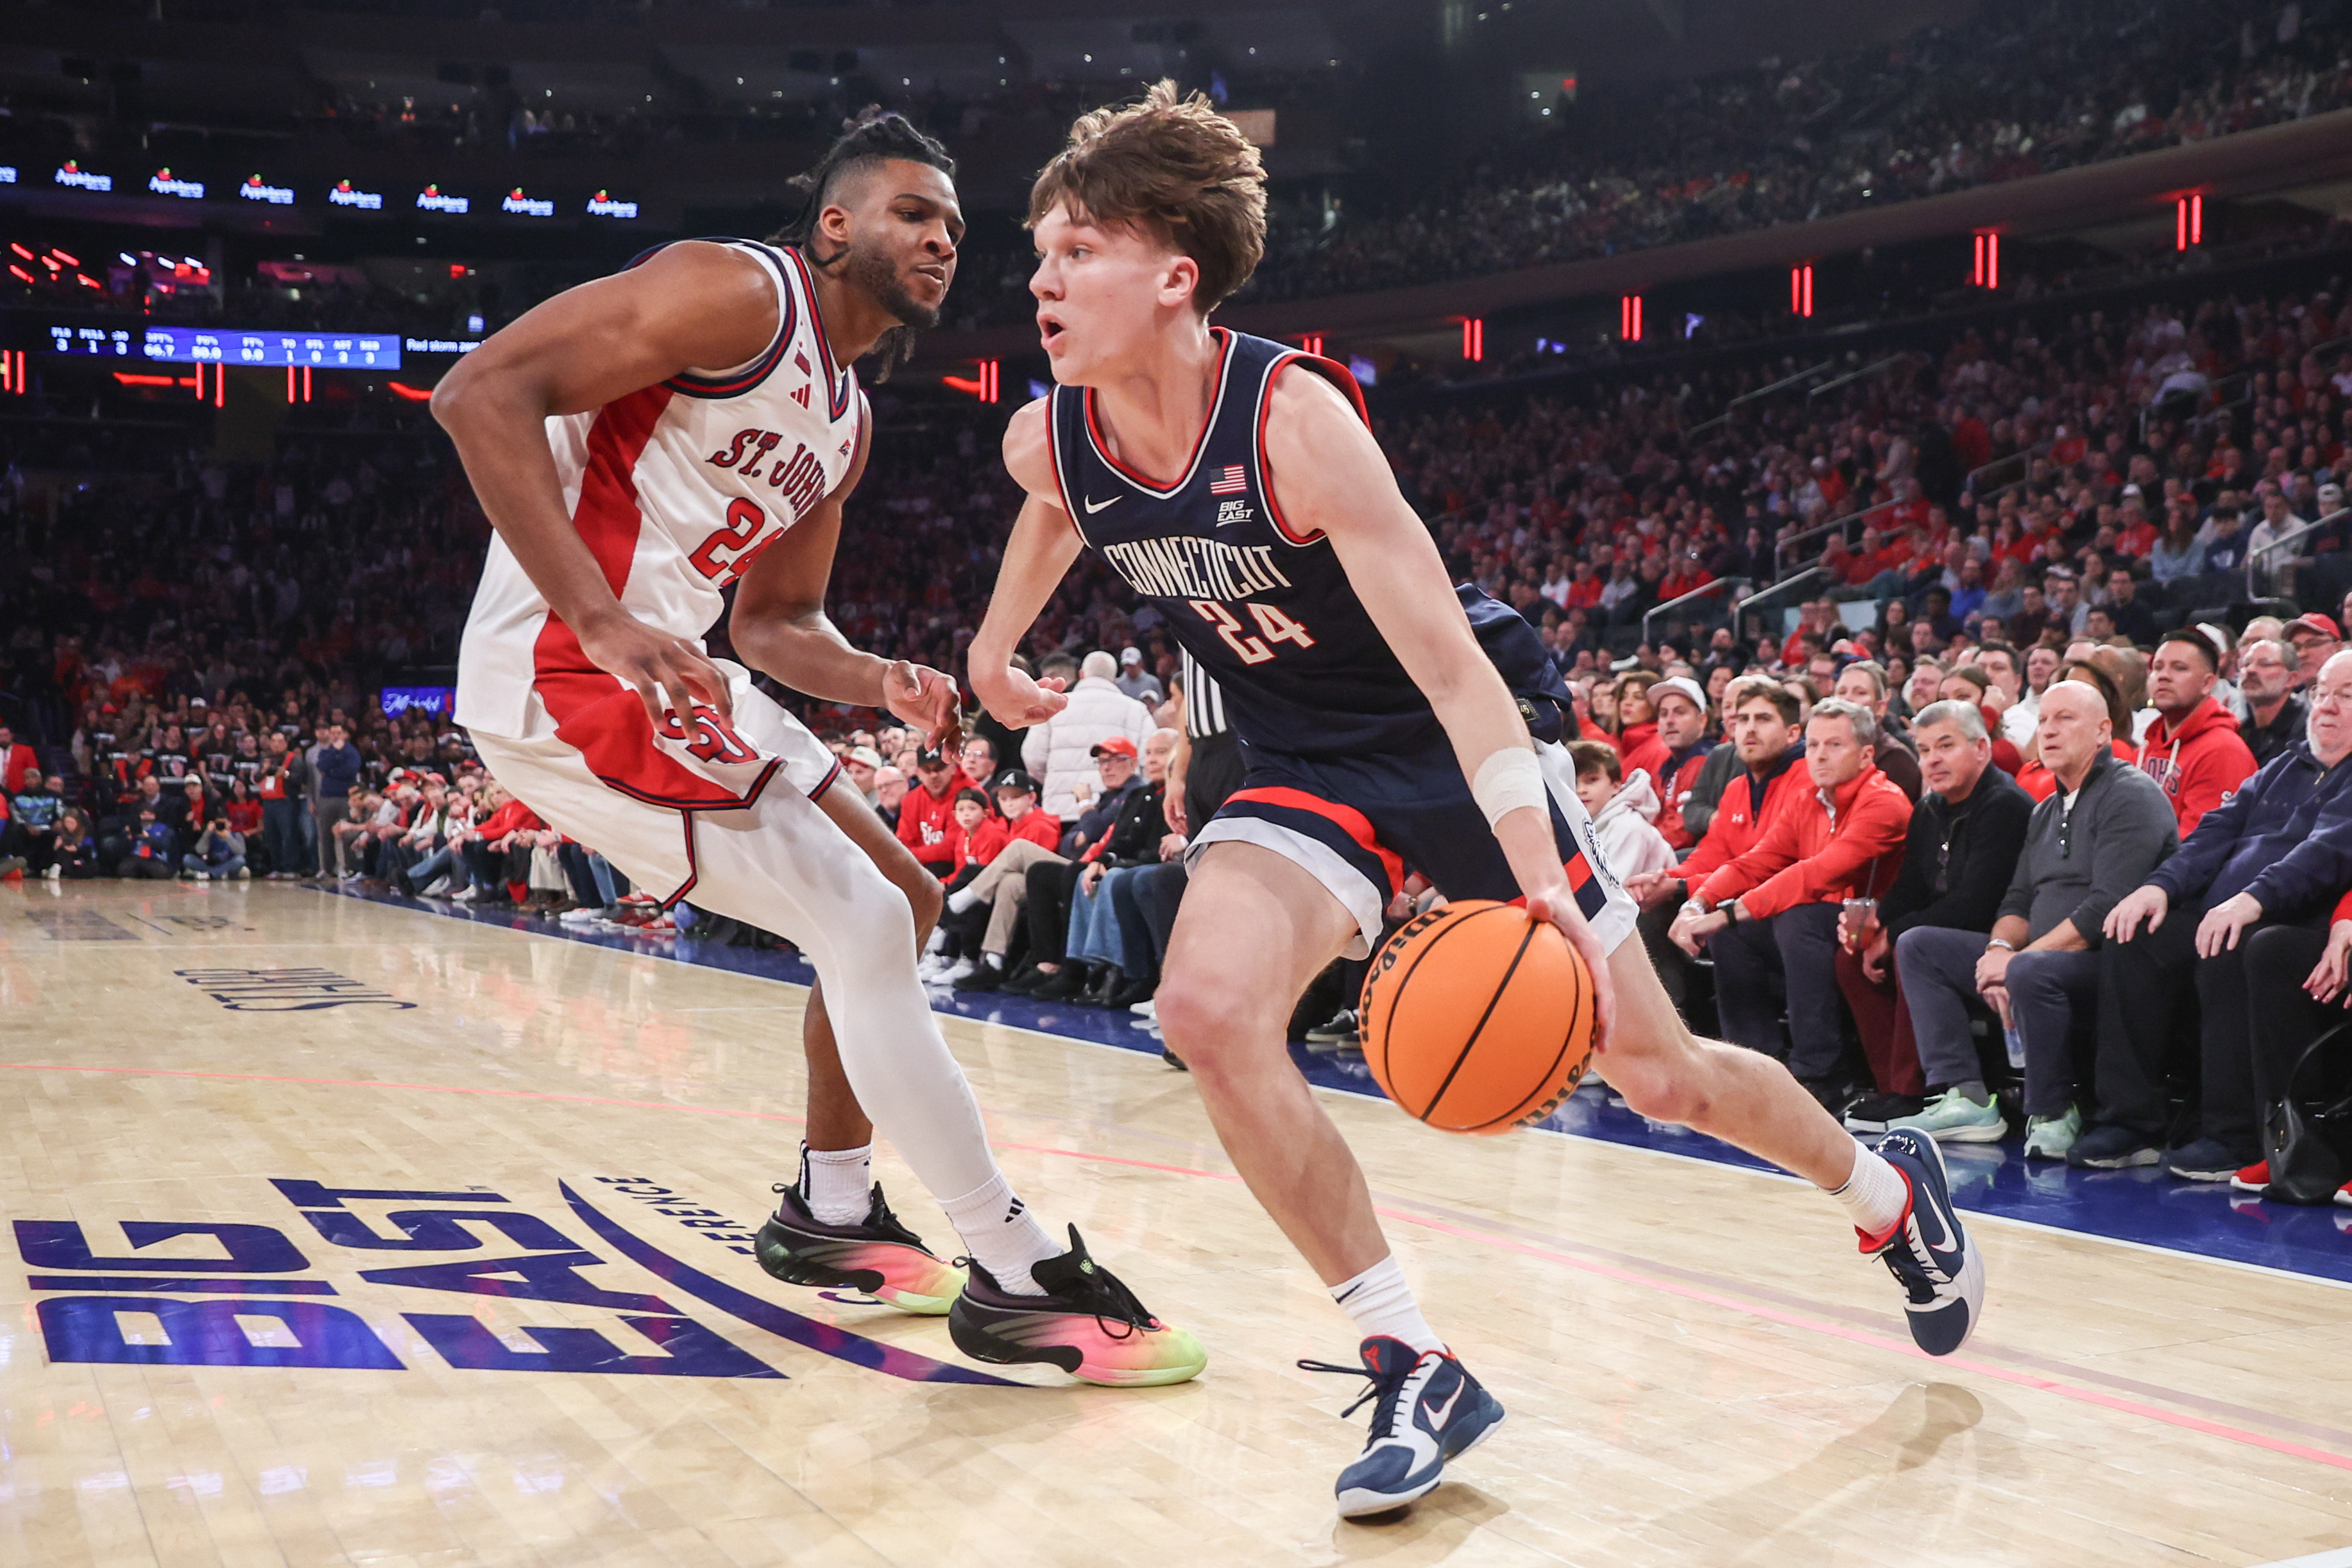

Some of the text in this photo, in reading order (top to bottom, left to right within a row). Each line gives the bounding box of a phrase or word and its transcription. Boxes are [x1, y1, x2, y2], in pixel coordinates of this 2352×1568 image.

[89, 339, 98, 354] 1
[286, 349, 294, 362] 1
[311, 350, 322, 363] 0
[706, 429, 783, 477] ST.
[1218, 508, 1254, 522] EAST
[1219, 500, 1245, 512] BIG
[1103, 536, 1292, 602] CONNECTICUT
[1188, 600, 1318, 666] 24
[1361, 909, 1454, 1043] Wilson
[13, 1220, 407, 1370] BIG
[268, 1178, 790, 1379] EAST
